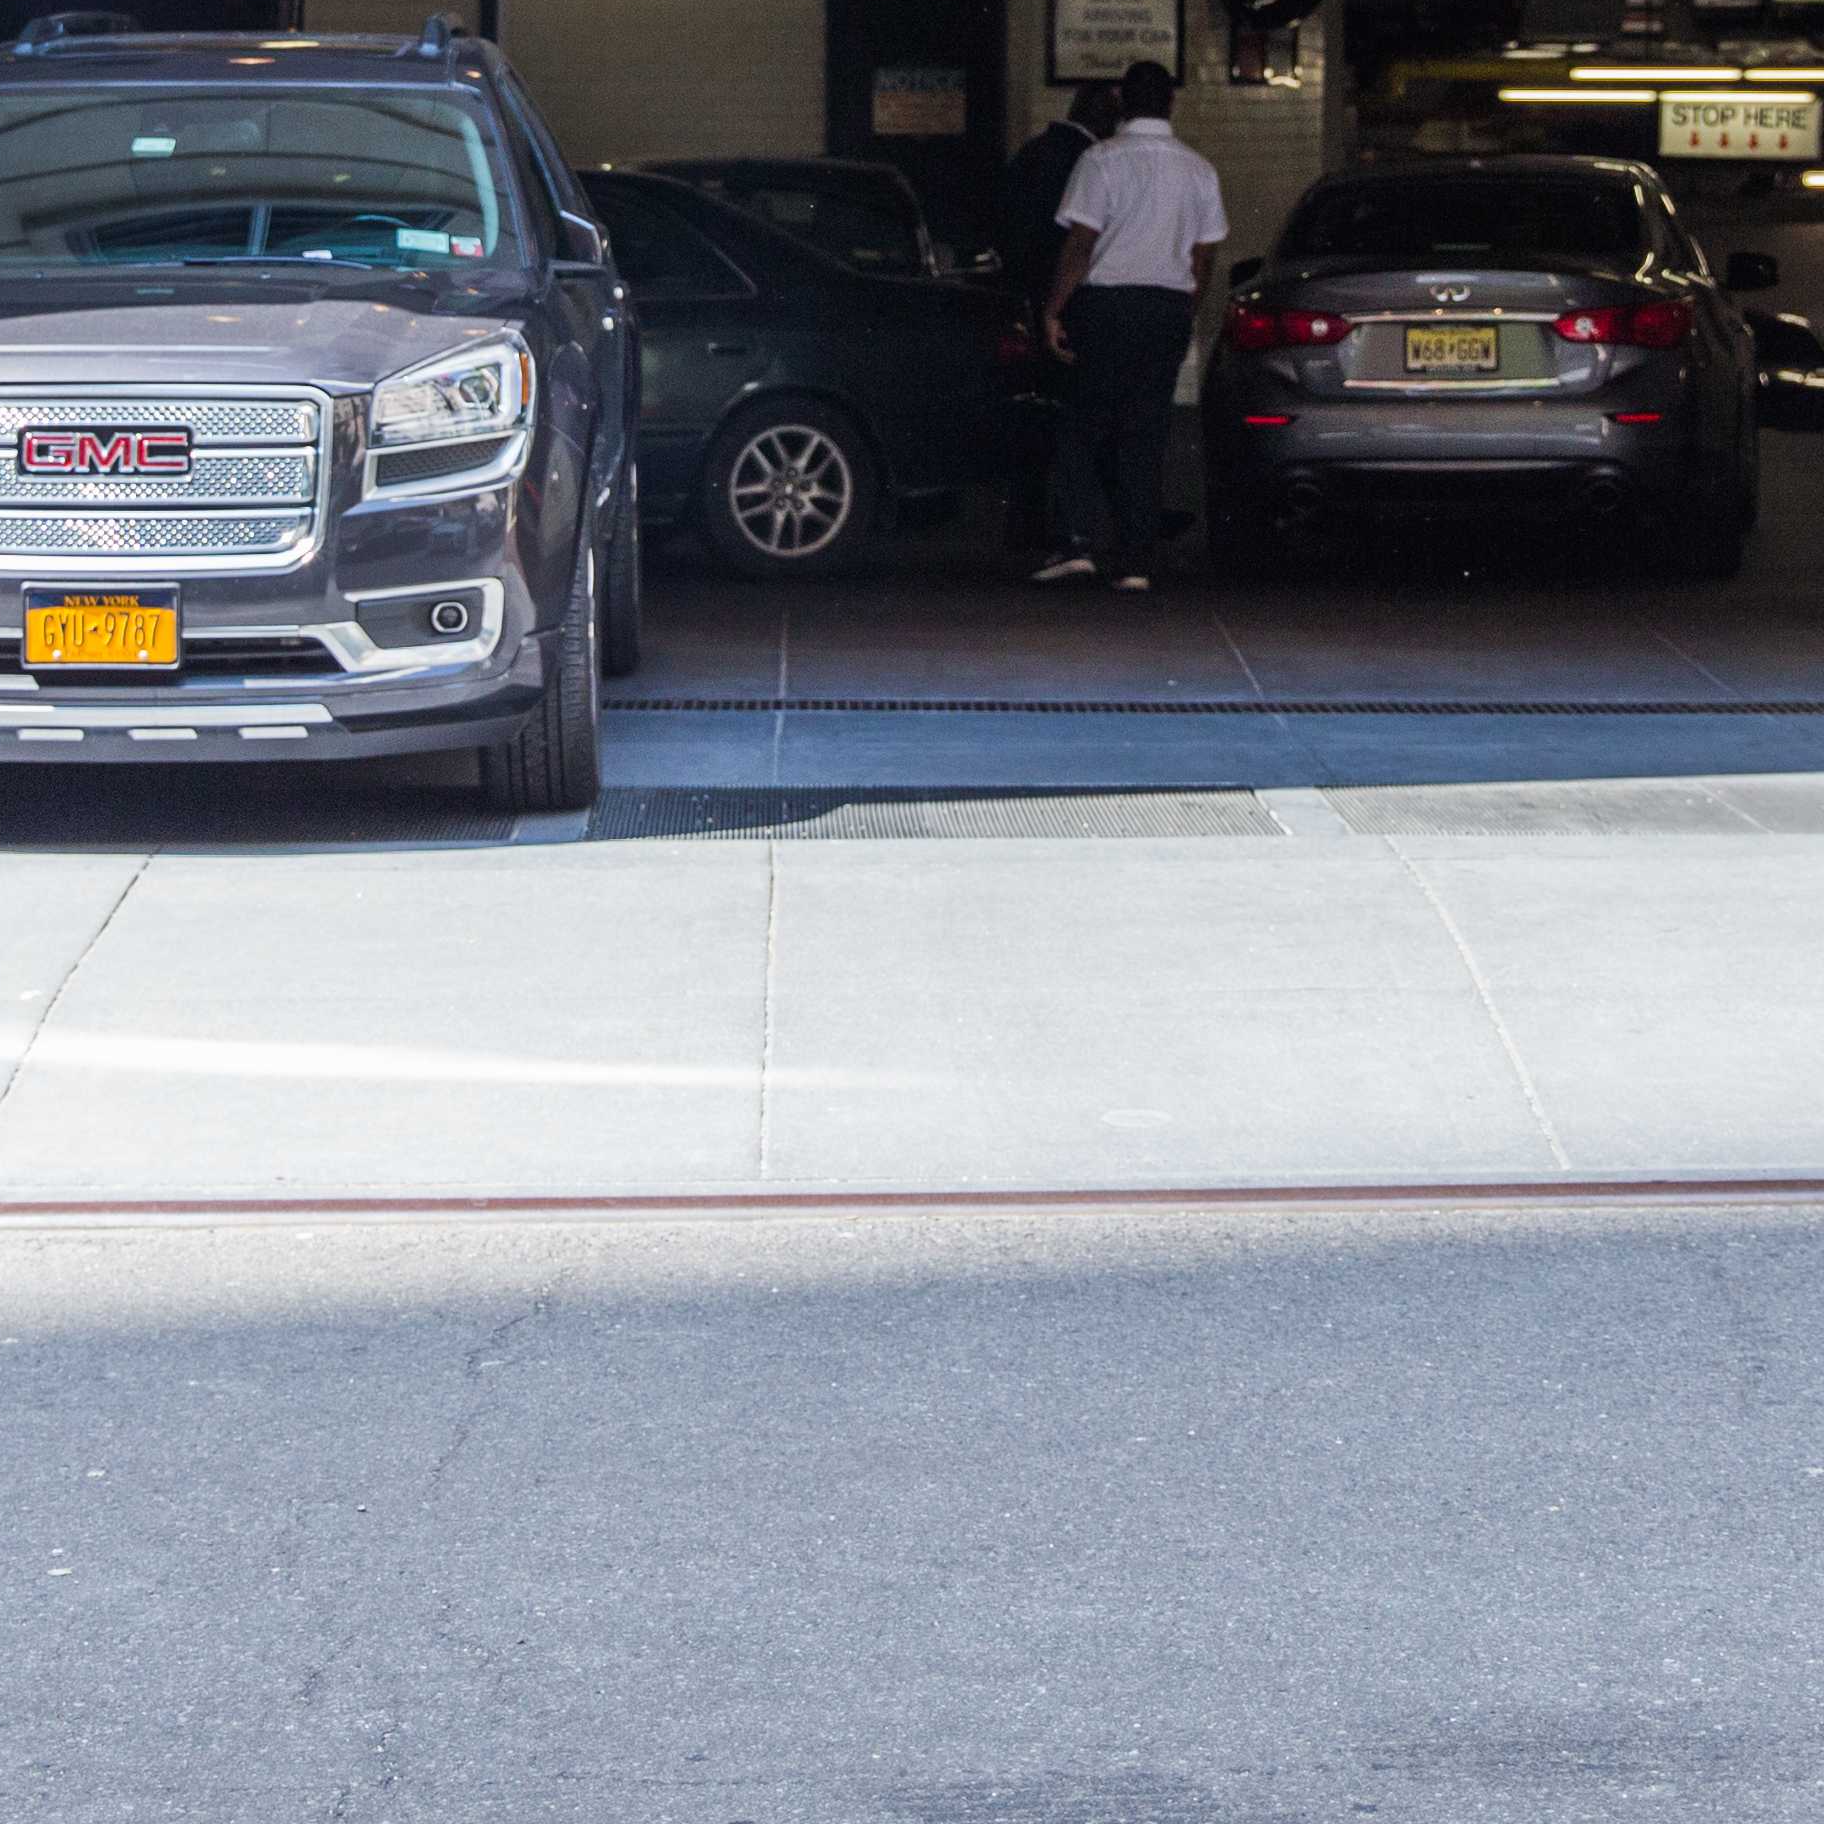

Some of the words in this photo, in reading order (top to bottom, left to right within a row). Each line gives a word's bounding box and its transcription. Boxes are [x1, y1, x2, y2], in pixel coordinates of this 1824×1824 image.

[1671, 105, 1737, 128] STOP
[1743, 107, 1808, 130] HERE
[23, 432, 188, 473] GMC
[63, 595, 97, 608] NEW
[102, 595, 140, 608] YORK
